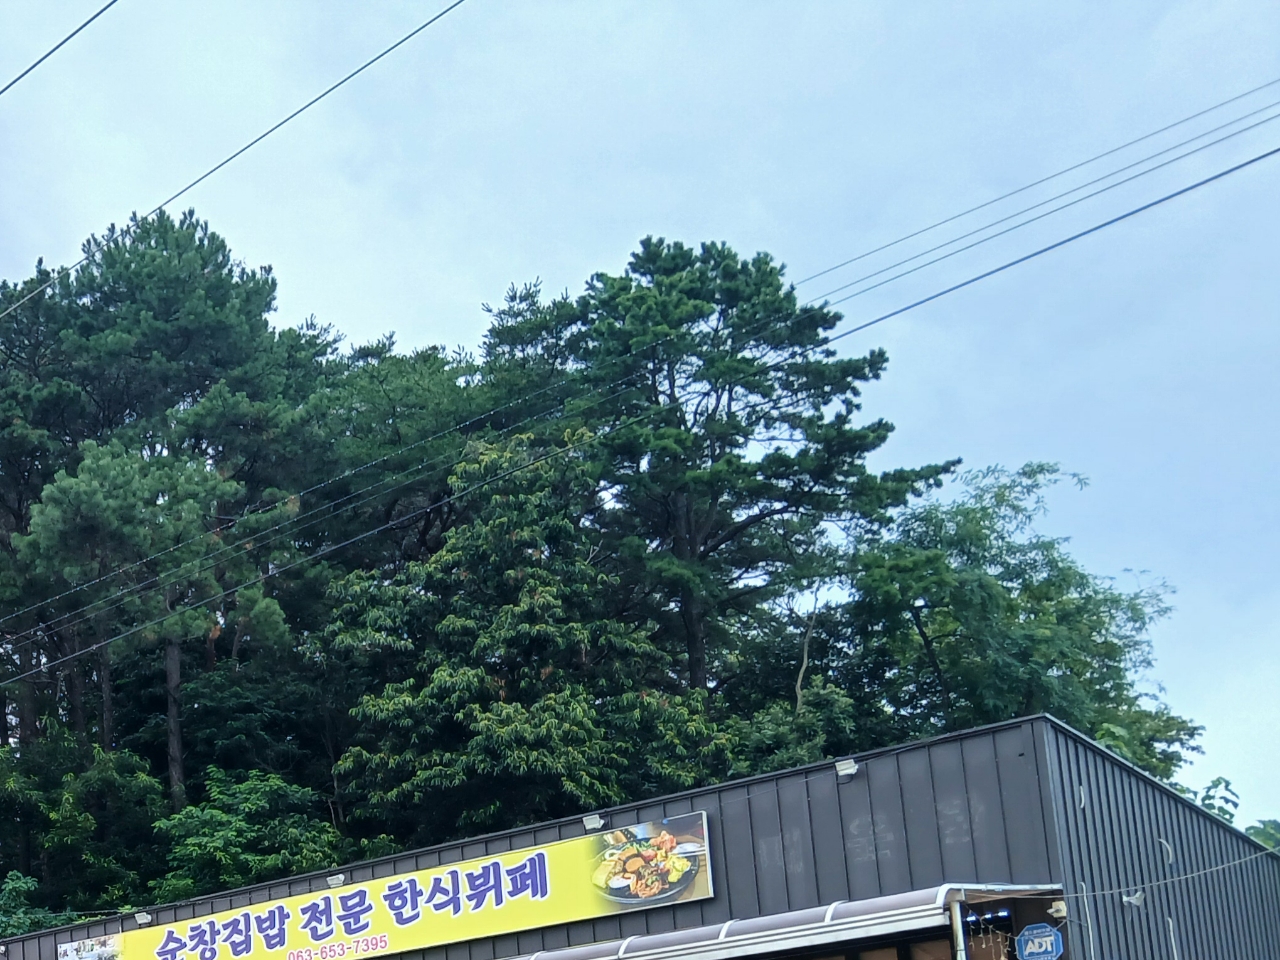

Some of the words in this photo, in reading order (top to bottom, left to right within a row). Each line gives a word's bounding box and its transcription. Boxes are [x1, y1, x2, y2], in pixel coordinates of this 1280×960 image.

[298, 887, 374, 939] 전문
[384, 851, 550, 927] 한식뷔페
[1024, 936, 1054, 956] ADT
